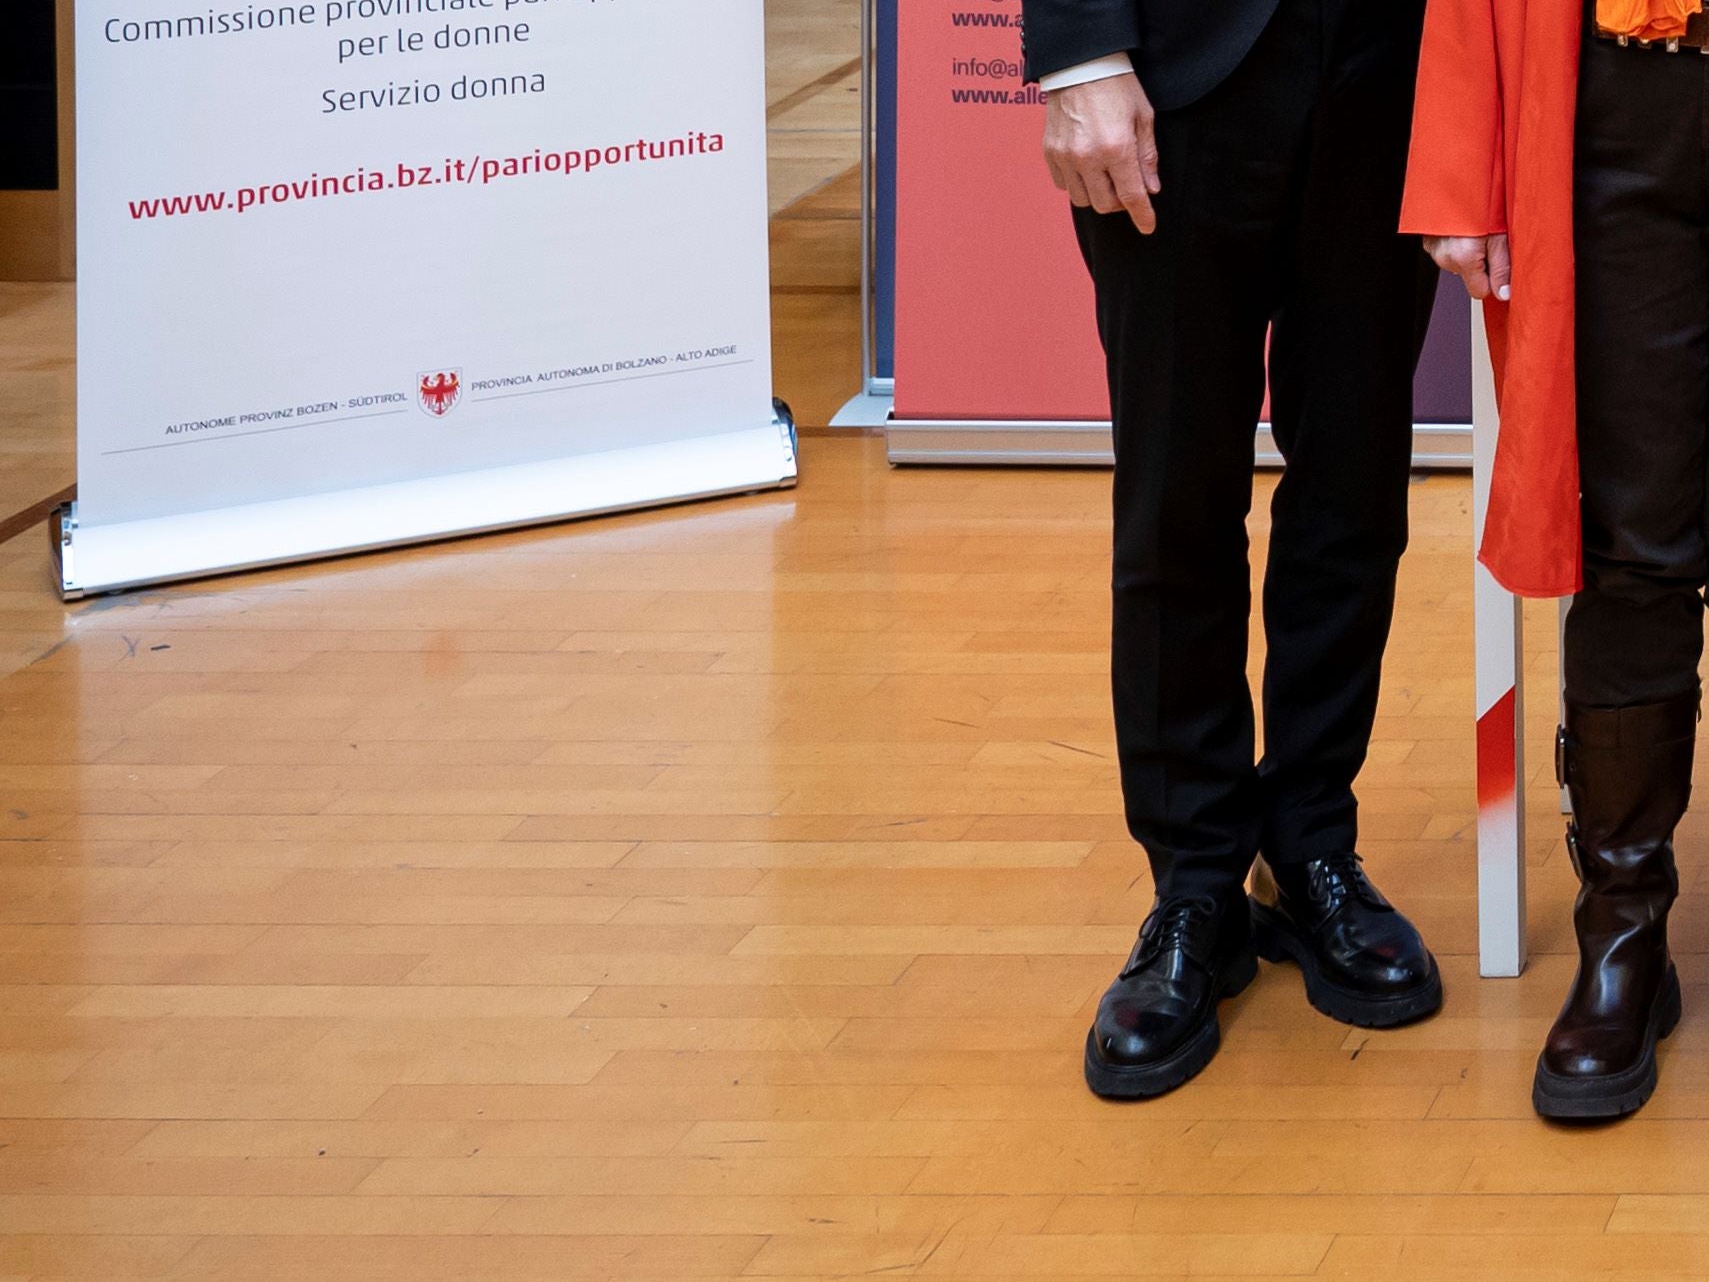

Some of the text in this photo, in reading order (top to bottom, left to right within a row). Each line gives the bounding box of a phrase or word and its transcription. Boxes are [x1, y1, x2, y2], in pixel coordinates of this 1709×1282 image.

[104, 0, 316, 44] Commissione
[338, 20, 531, 64] per le donne
[322, 71, 546, 114] Servizio donna
[128, 131, 725, 220] www.provincia.bz.it/pariopportunita
[471, 373, 533, 393] PROVINCIA
[537, 364, 601, 384] AUTONOMA
[602, 362, 614, 374] DI
[616, 354, 668, 372] BOLZANO
[675, 348, 703, 364] ALTO
[705, 343, 737, 360] ADIGE
[165, 416, 237, 436] AUTONOME
[239, 408, 294, 426] PROVINZ
[296, 401, 339, 417] BOZEN
[348, 389, 408, 410] SÜDTIROL
